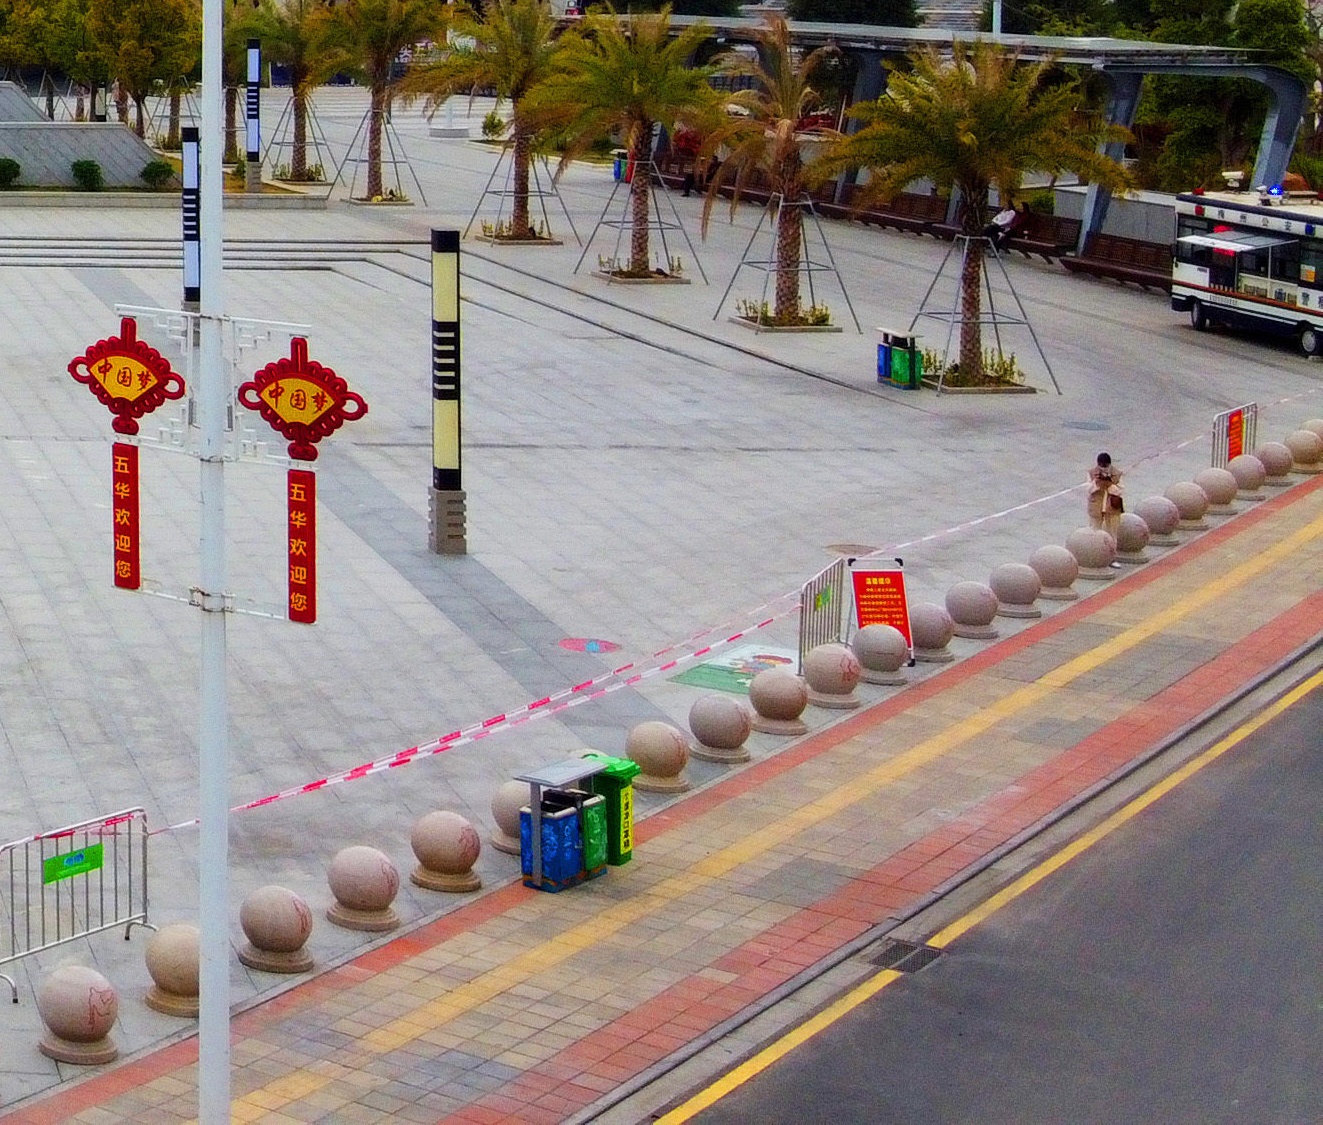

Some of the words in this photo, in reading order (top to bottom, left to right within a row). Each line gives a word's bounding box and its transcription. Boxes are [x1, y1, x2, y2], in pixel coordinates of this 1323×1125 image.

[97, 358, 153, 391] 中国梦
[268, 382, 329, 415] 中国梦
[114, 455, 132, 579] 五华欢迎您
[289, 483, 308, 612] 五华欢迎您
